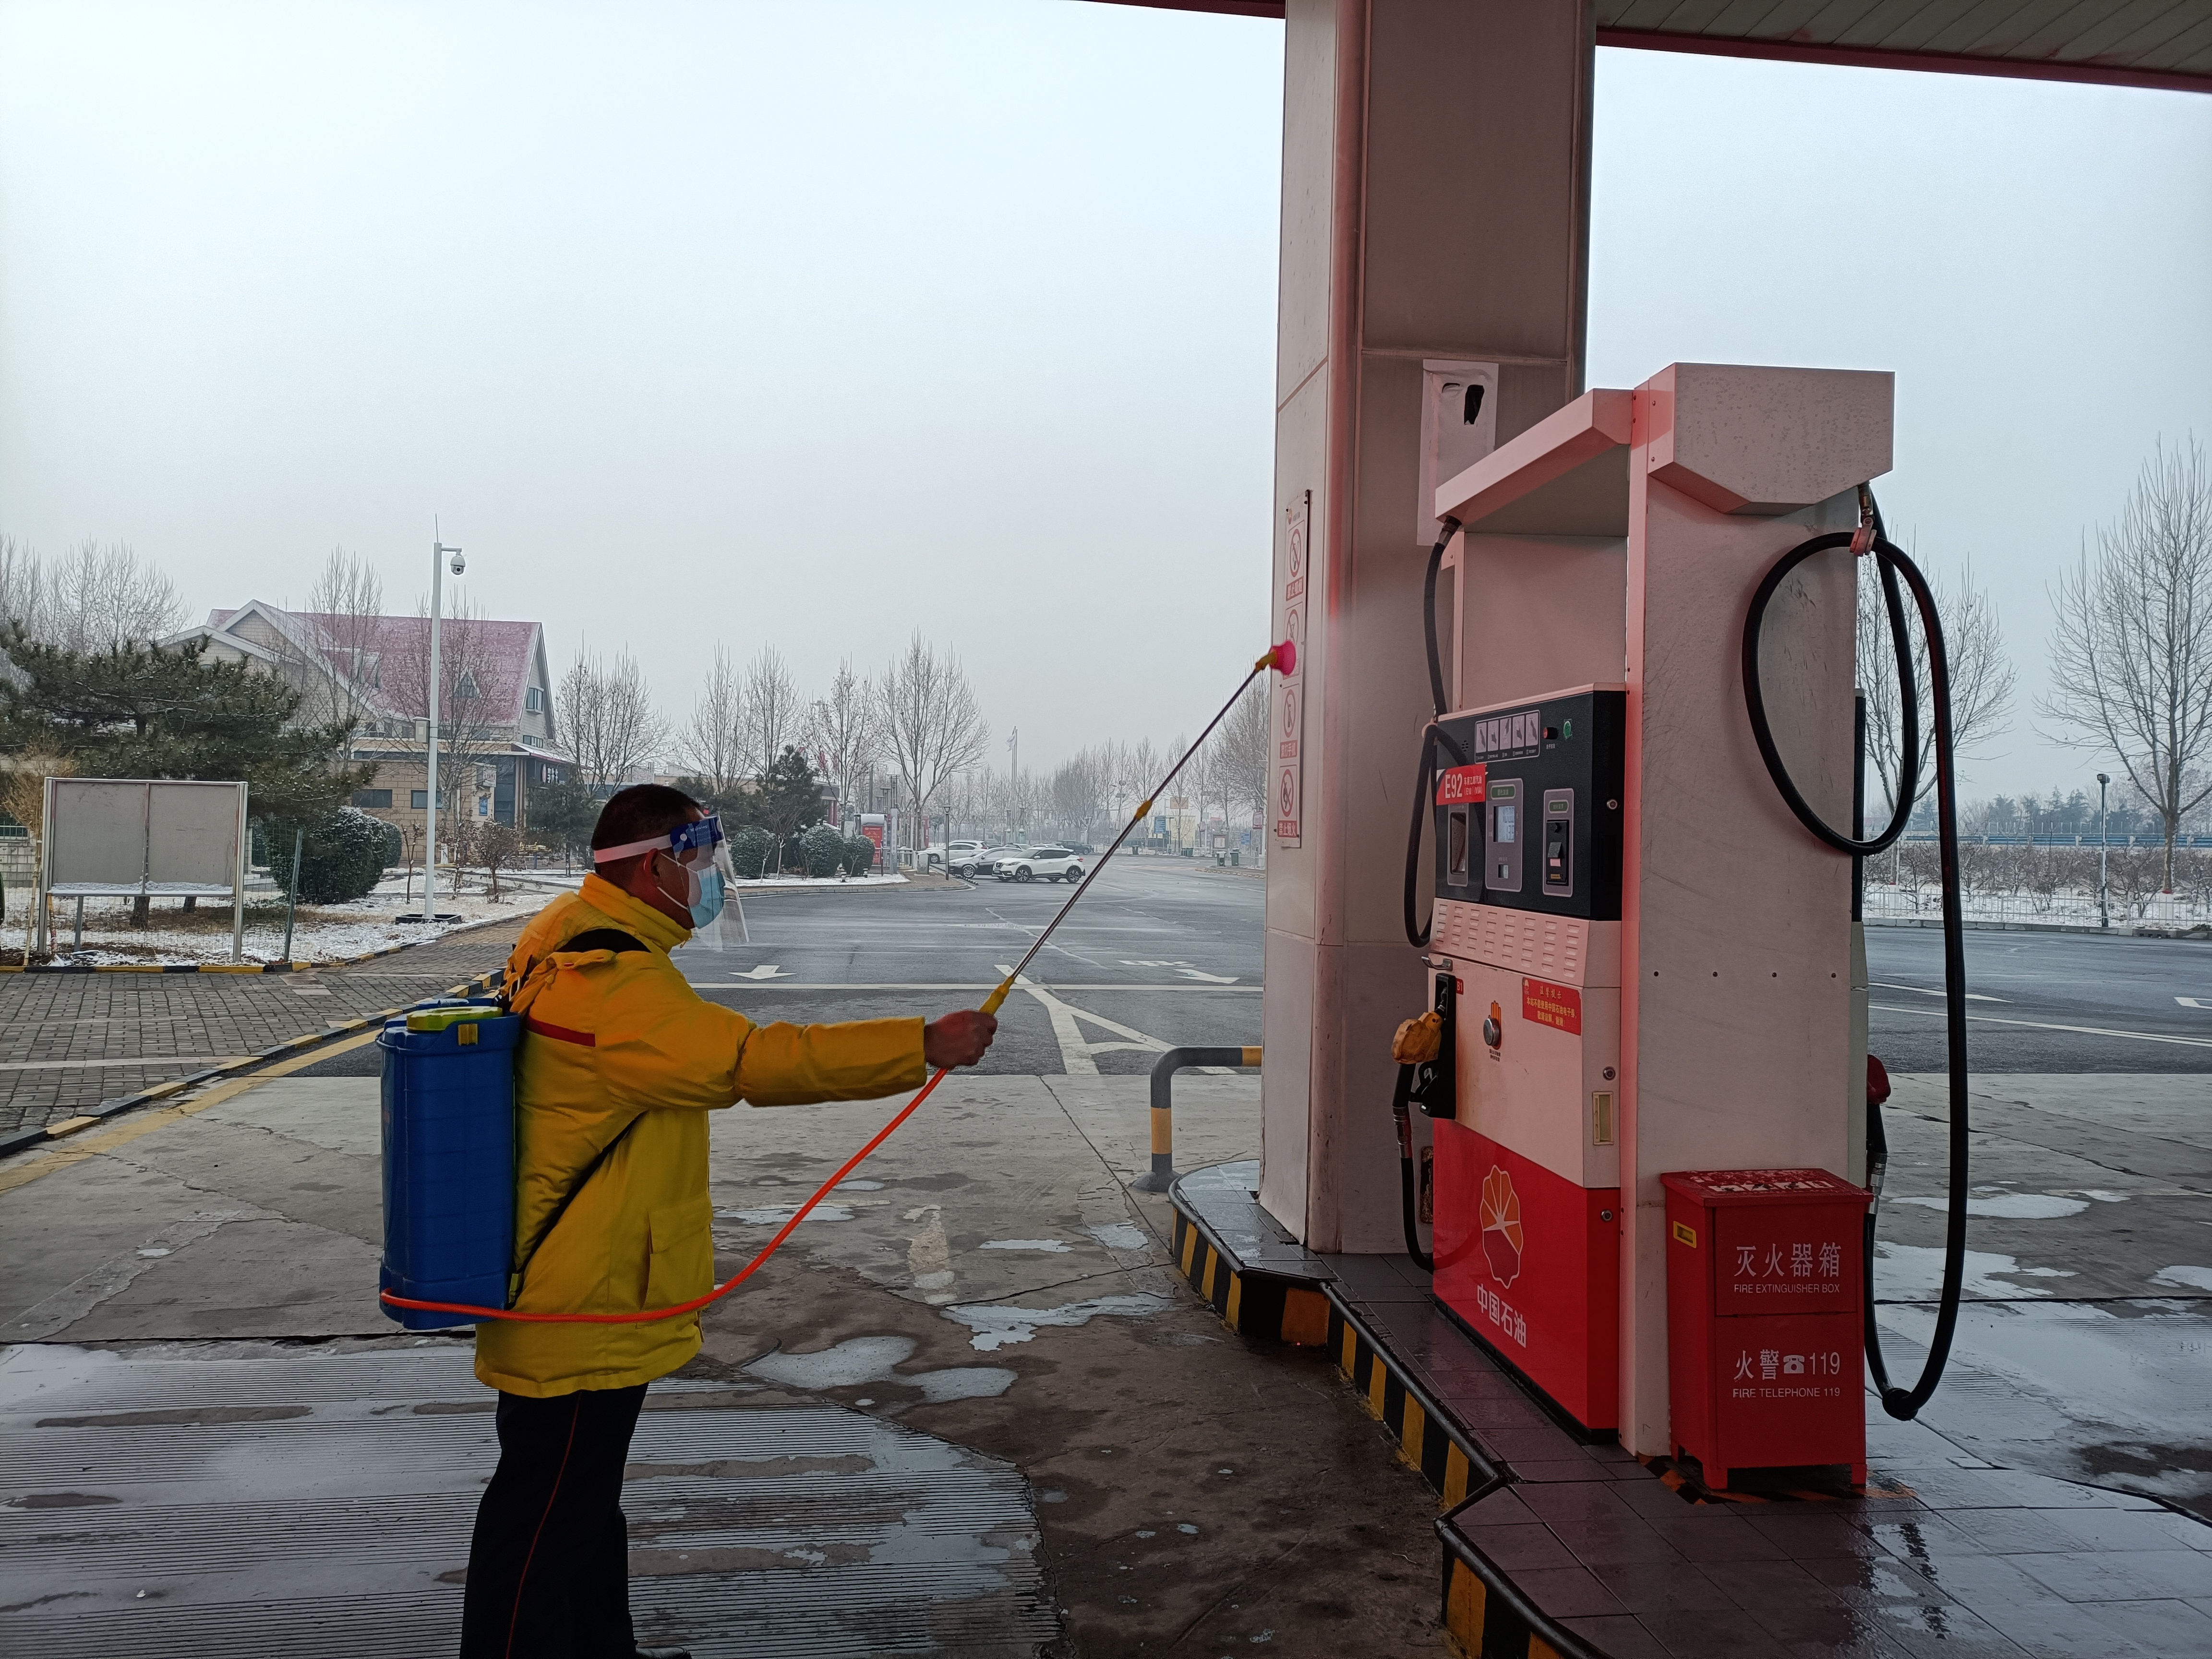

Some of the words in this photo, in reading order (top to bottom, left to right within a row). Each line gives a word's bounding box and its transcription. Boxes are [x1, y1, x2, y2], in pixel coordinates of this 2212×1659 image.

[1445, 773, 1463, 798] E92
[1279, 822, 1296, 836] 禁止烟火
[1457, 981, 1463, 992] B1
[1540, 986, 1562, 999] 温馨提示
[1734, 1242, 1841, 1277] 灭火器箱
[1734, 1284, 1754, 1293] FIRE
[1756, 1284, 1819, 1293] EXTINGUISHER
[1822, 1284, 1840, 1293] BOX
[1477, 1283, 1526, 1348] 中国石油
[1733, 1349, 1779, 1380] 火警
[1809, 1352, 1840, 1375] 119
[1733, 1388, 1756, 1398] FIRE
[1759, 1388, 1820, 1397] TELEPHONE
[1824, 1387, 1840, 1397] 119
